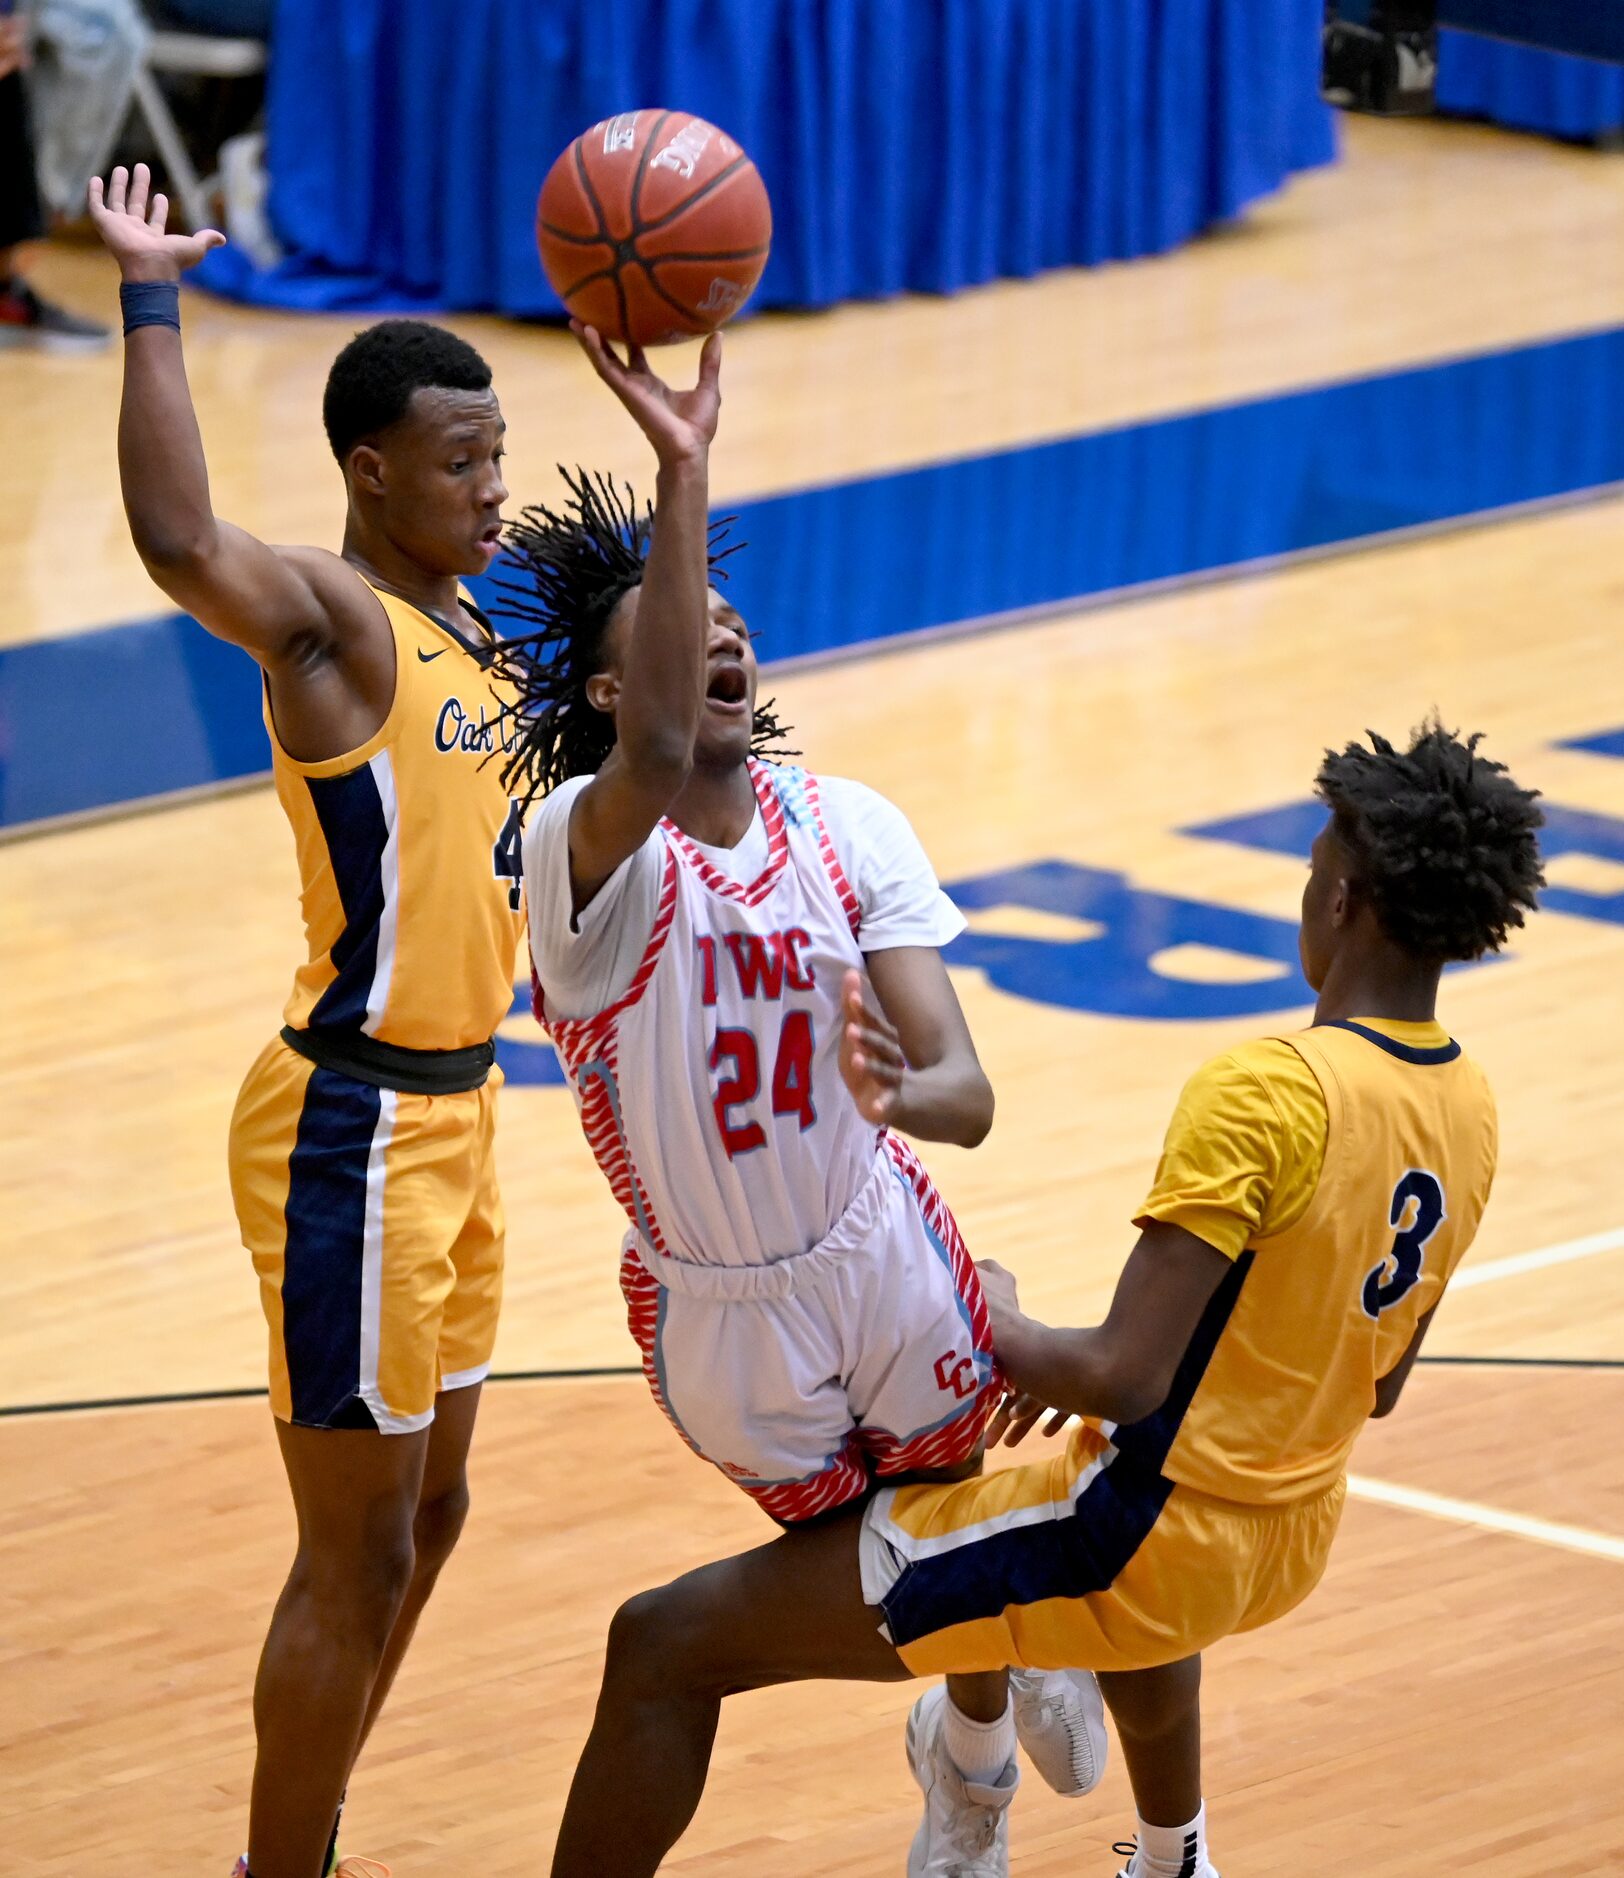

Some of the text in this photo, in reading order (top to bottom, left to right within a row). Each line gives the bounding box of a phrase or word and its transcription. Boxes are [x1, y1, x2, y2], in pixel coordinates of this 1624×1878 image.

[434, 696, 494, 753] Oak
[707, 1009, 817, 1161] 24
[1361, 1168, 1448, 1321] 3
